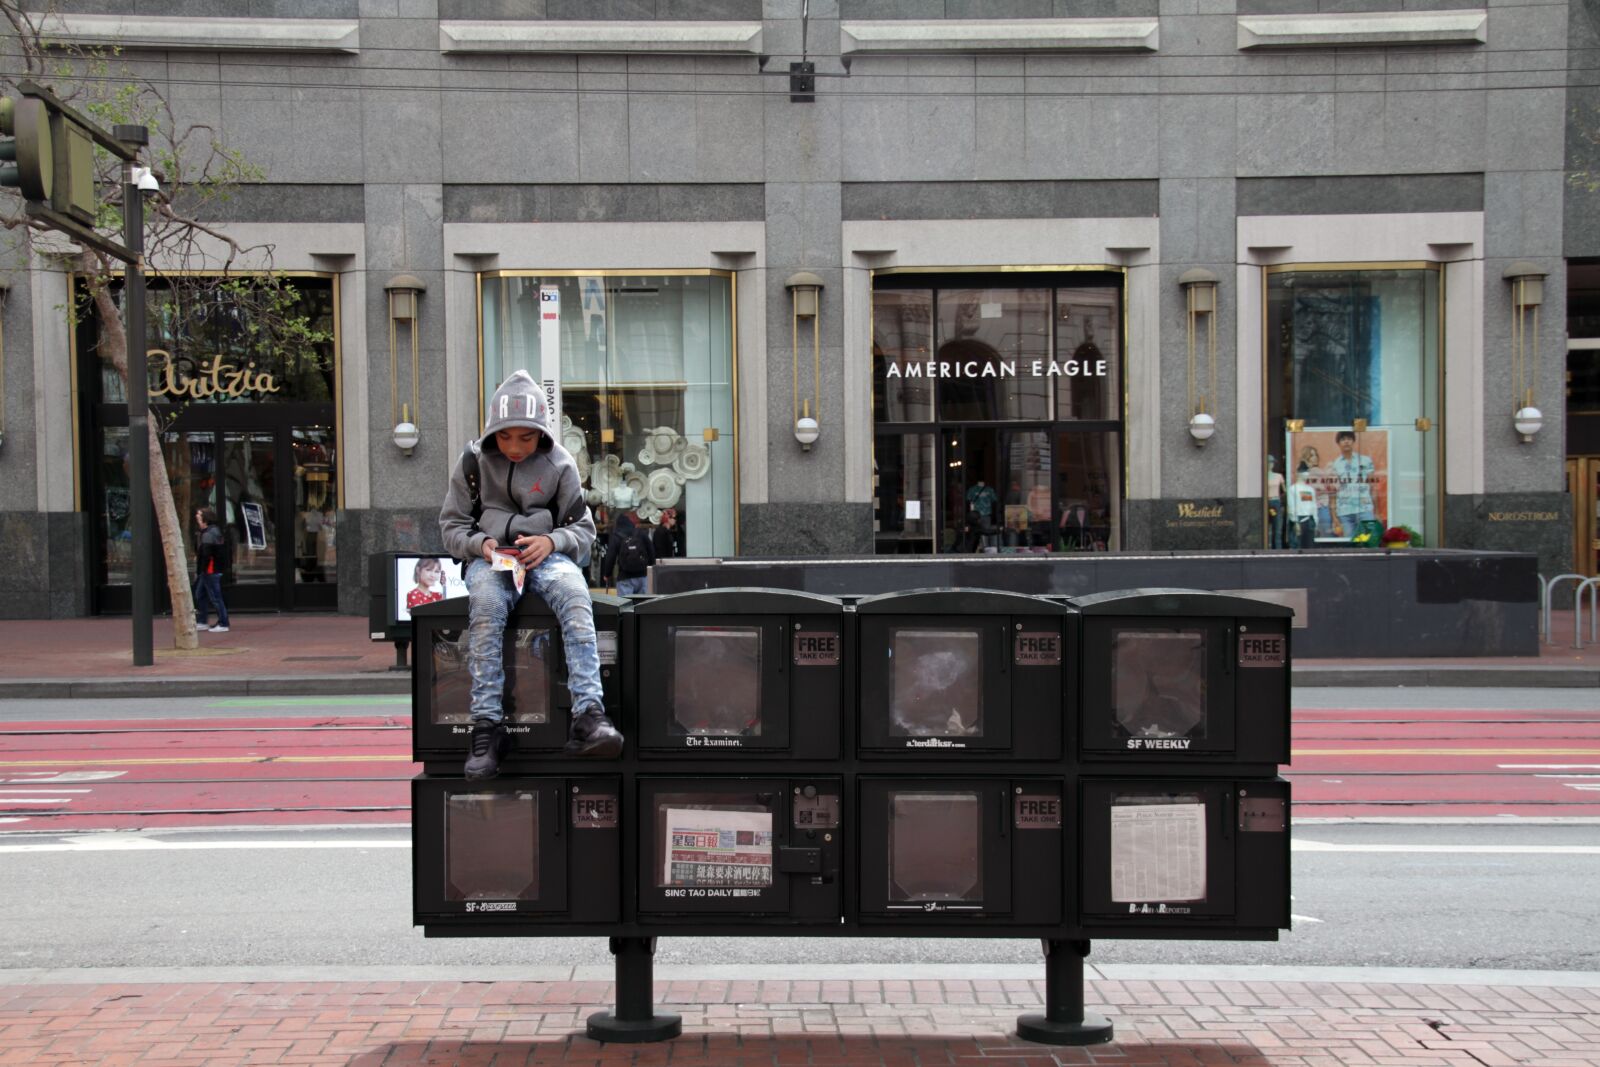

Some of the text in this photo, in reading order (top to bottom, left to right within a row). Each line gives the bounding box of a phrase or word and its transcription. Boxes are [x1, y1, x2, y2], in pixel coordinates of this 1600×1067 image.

[147, 349, 280, 399] Aritzia
[886, 360, 1107, 378] AMERICAN EAGLE
[544, 379, 555, 417] owell
[1178, 502, 1224, 518] Westfield
[1488, 511, 1559, 521] NORDSTROM
[799, 637, 834, 651] FREE
[1020, 637, 1056, 651] FREE
[1244, 639, 1280, 653] FREE
[452, 720, 466, 734] San
[686, 736, 702, 747] The
[1127, 739, 1190, 749] SF WEEKLY
[577, 799, 614, 814] FREE
[1020, 800, 1057, 815] FREE
[672, 834, 718, 849] 星島日報
[665, 888, 732, 897] SING TAO DAILY
[466, 902, 477, 912] SF
